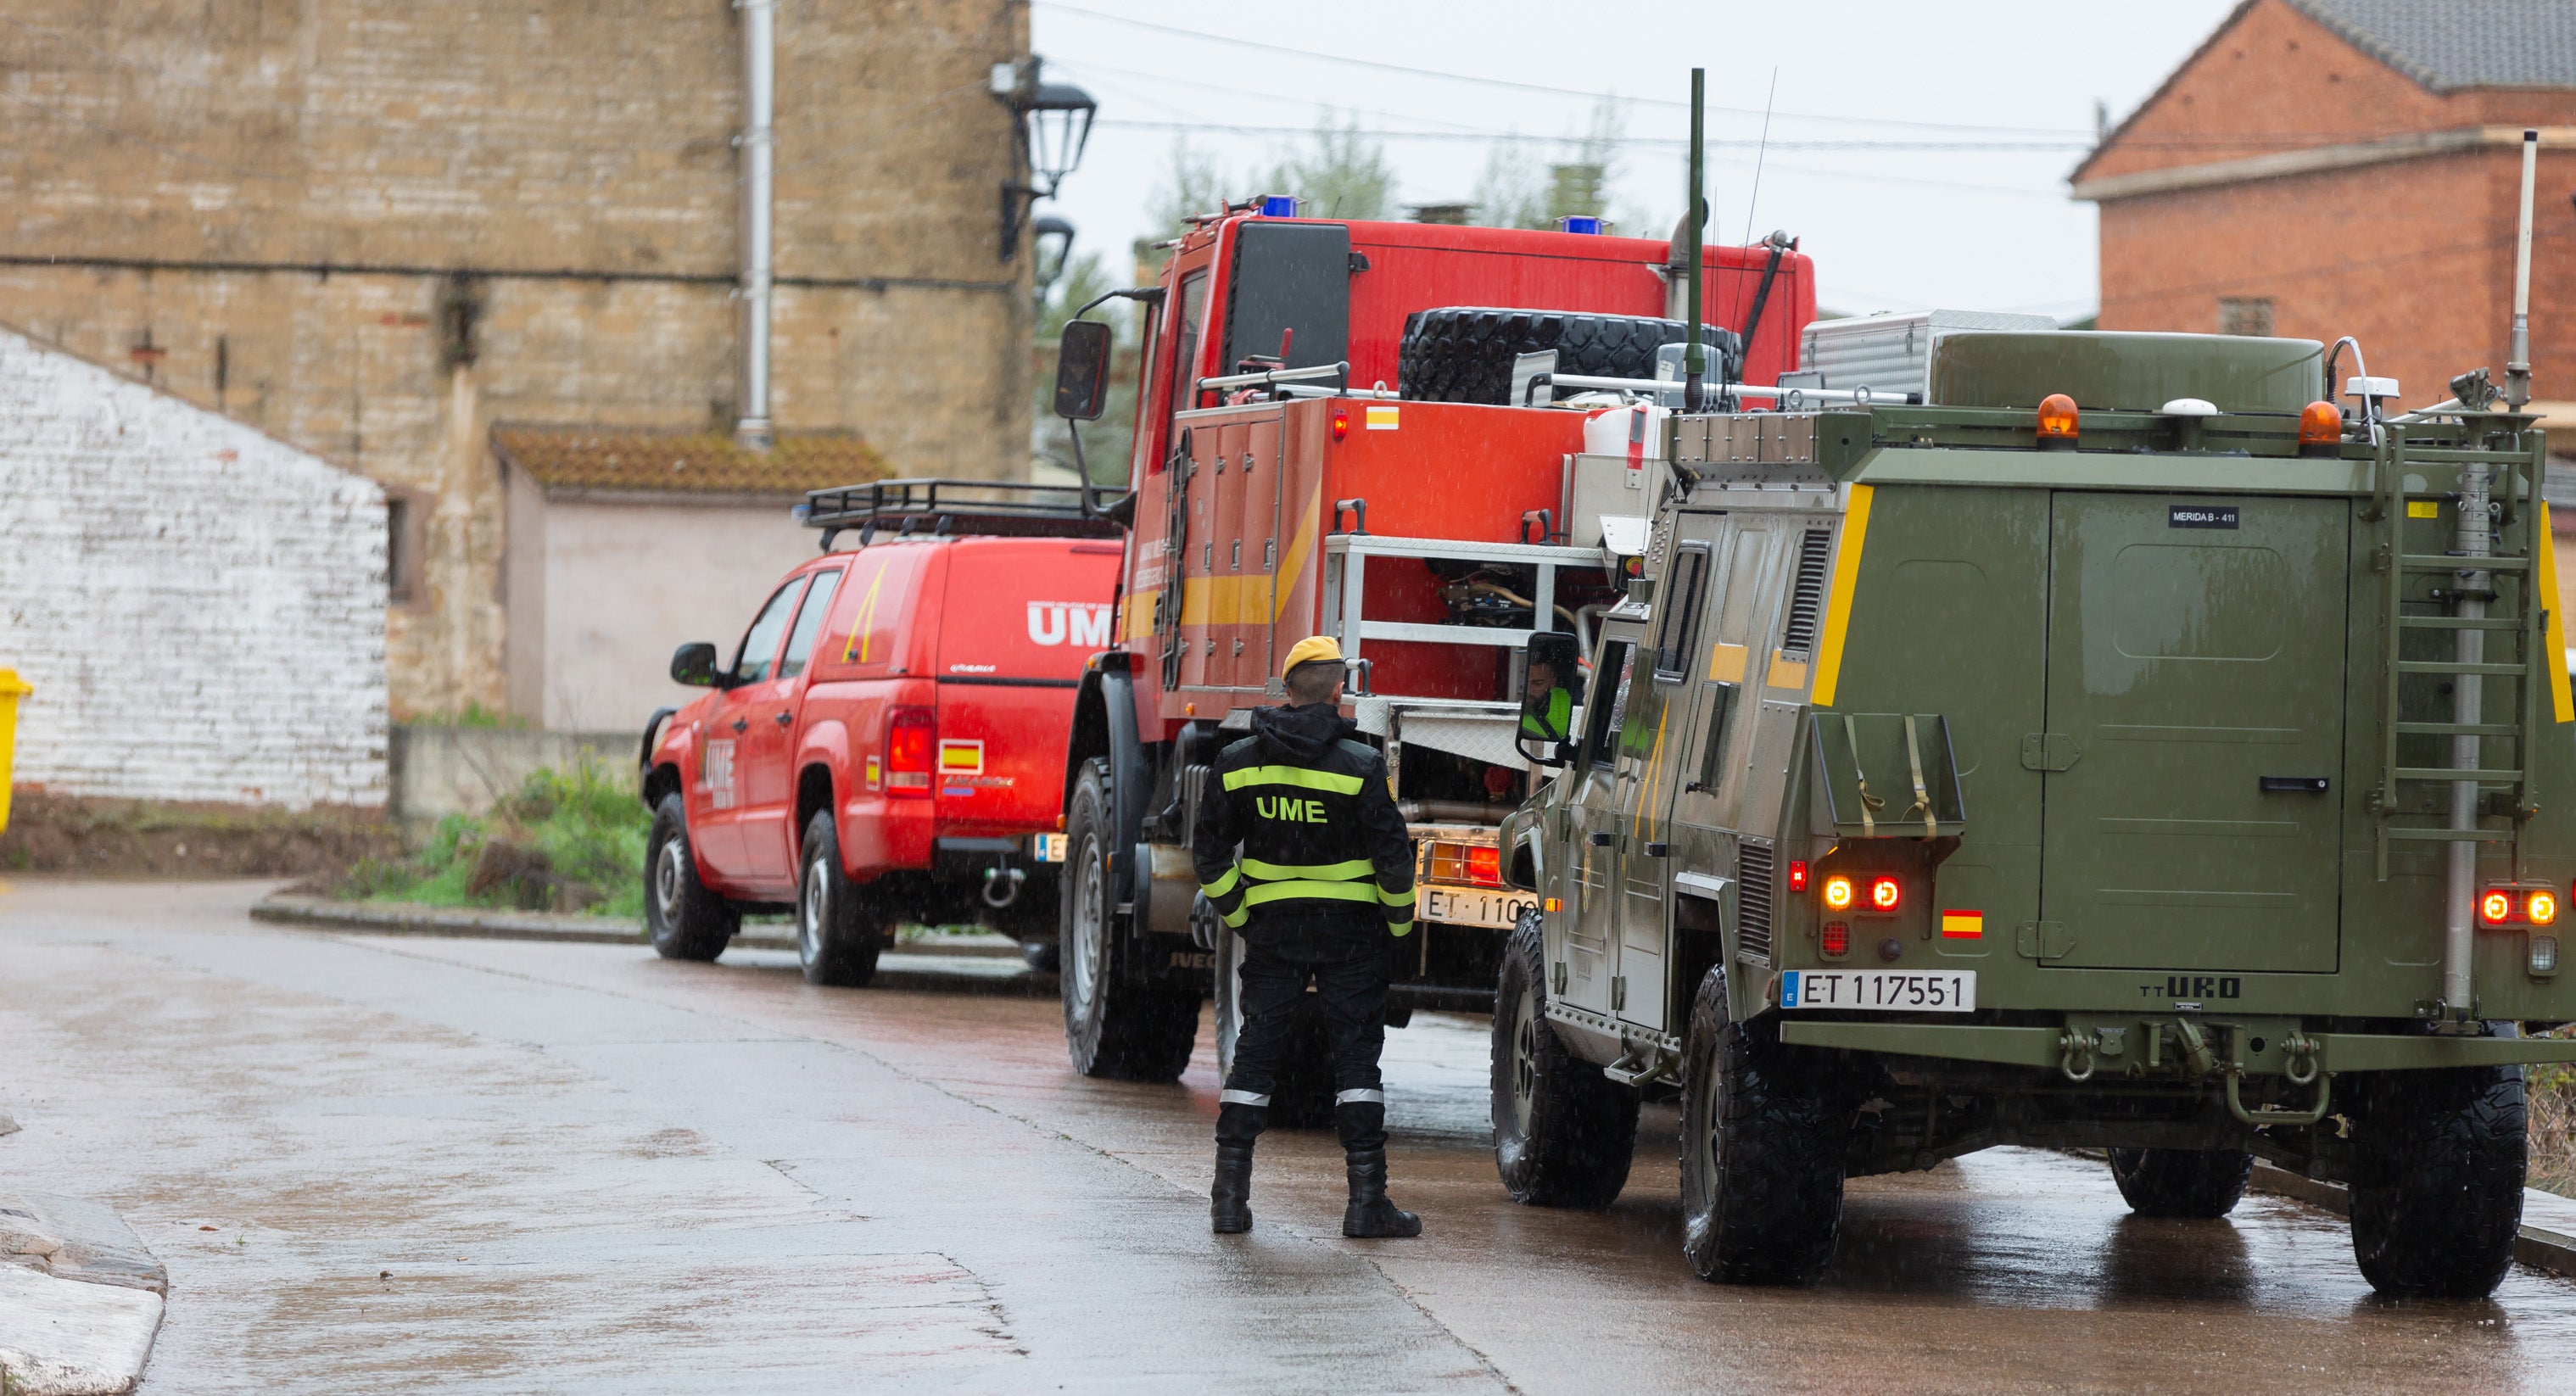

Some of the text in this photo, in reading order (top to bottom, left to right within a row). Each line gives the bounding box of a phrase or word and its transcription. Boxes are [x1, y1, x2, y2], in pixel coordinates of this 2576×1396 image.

[2173, 511, 2206, 522] MERIDA
[2208, 512, 2215, 522] B
[2221, 513, 2235, 522] 411
[1027, 606, 1114, 647] UM
[1256, 796, 1327, 824] UME
[1428, 891, 1460, 918] ET
[1171, 952, 1215, 969] IVEC
[1804, 975, 1842, 1002] ET
[1853, 975, 1961, 1007] 117551
[2167, 976, 2240, 999] URO
